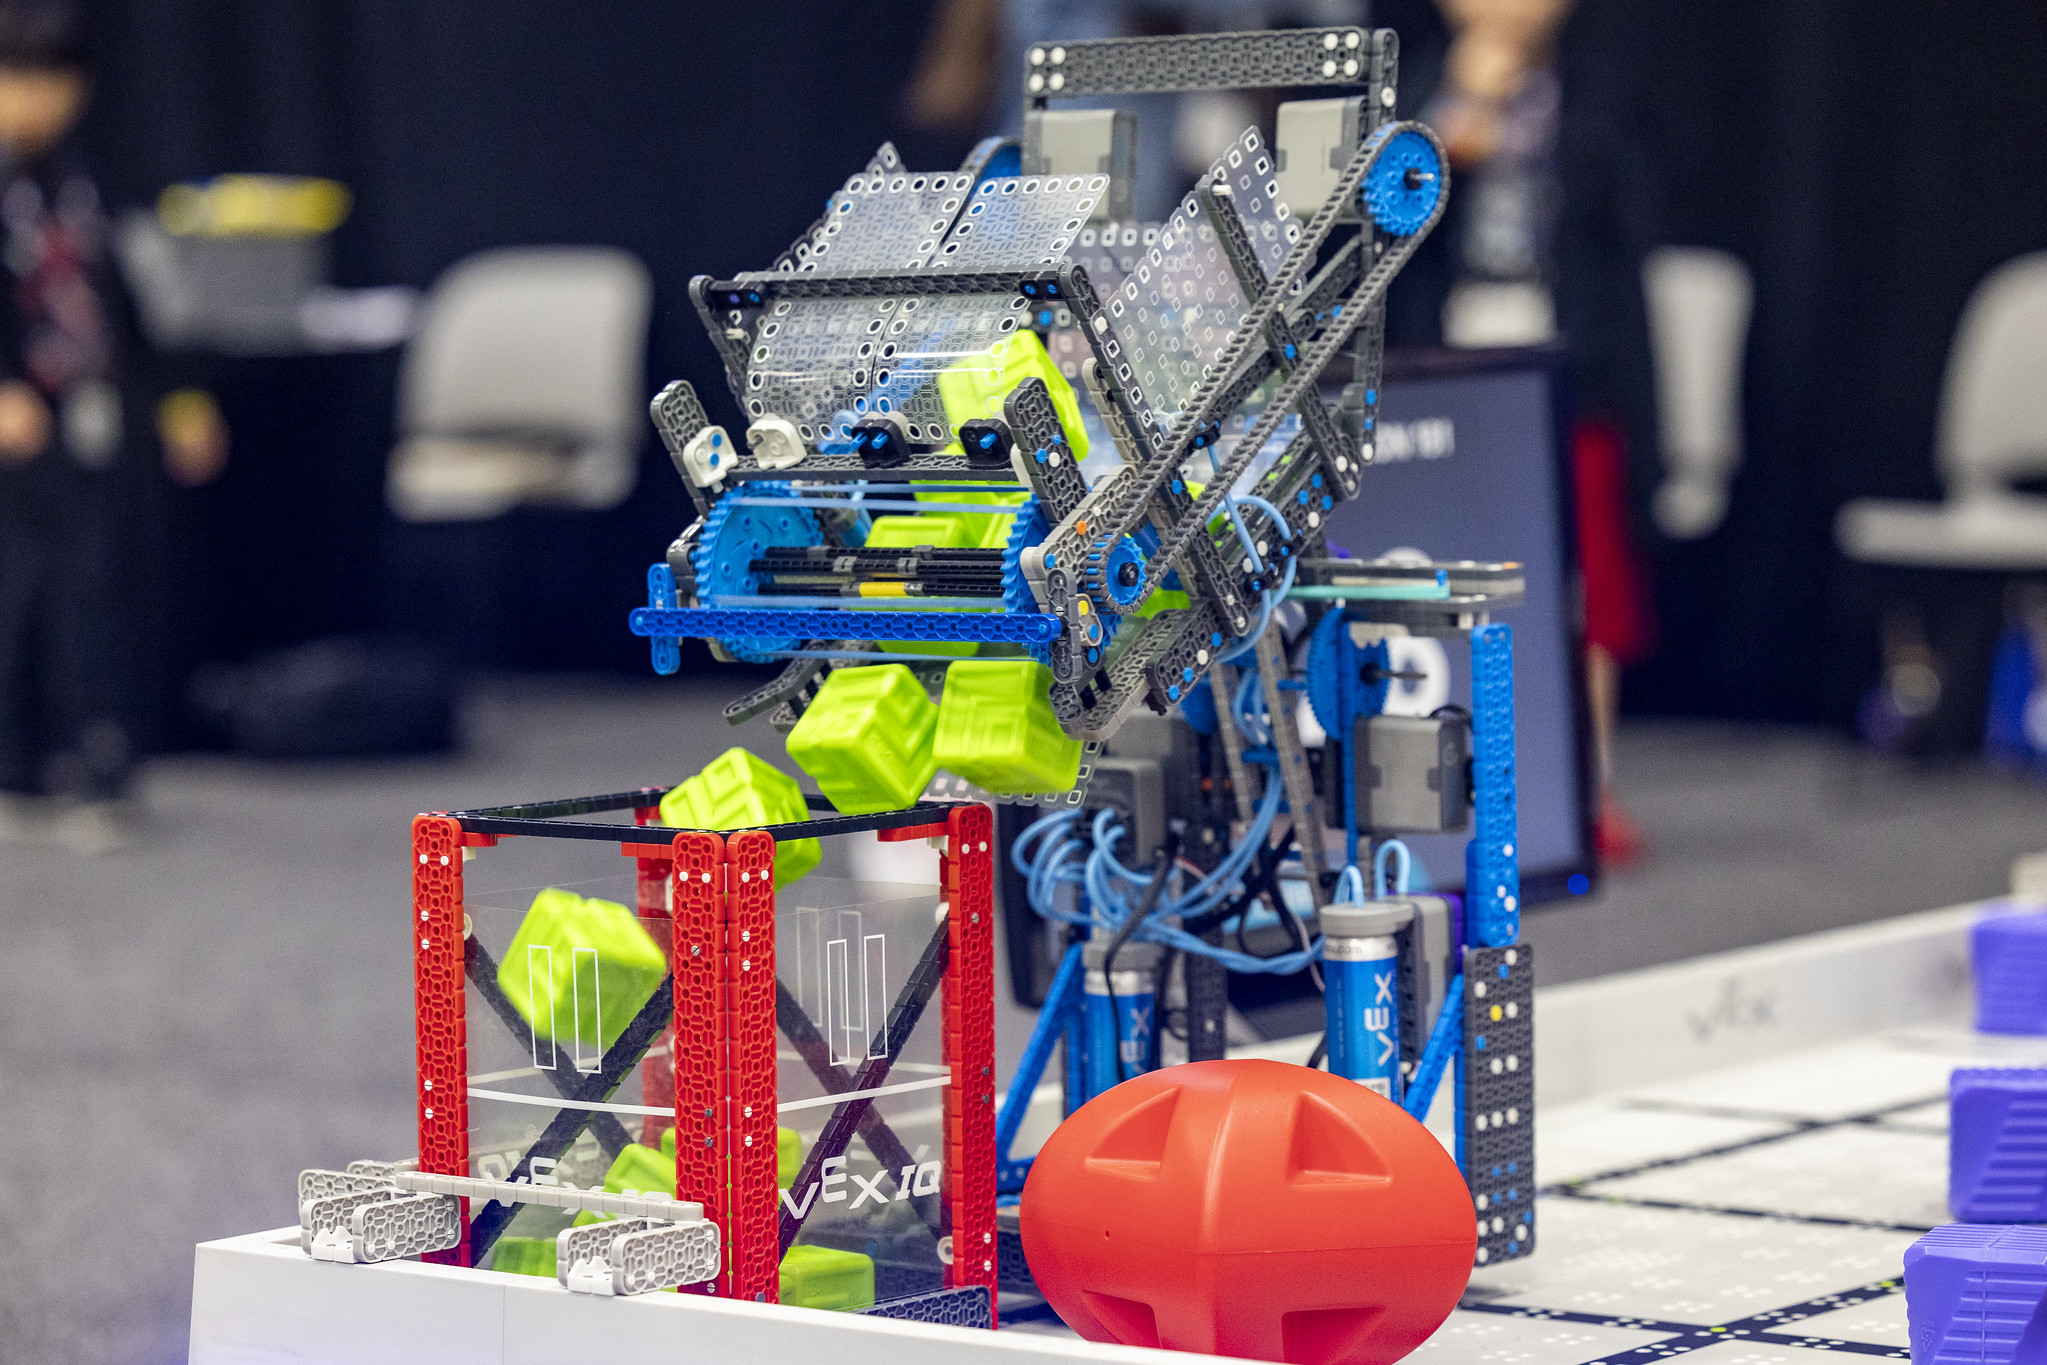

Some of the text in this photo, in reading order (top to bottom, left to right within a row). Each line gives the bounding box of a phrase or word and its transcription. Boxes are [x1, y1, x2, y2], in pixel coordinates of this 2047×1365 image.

[1364, 972, 1394, 1067] VEX
[778, 1155, 943, 1220] VEX IQ
